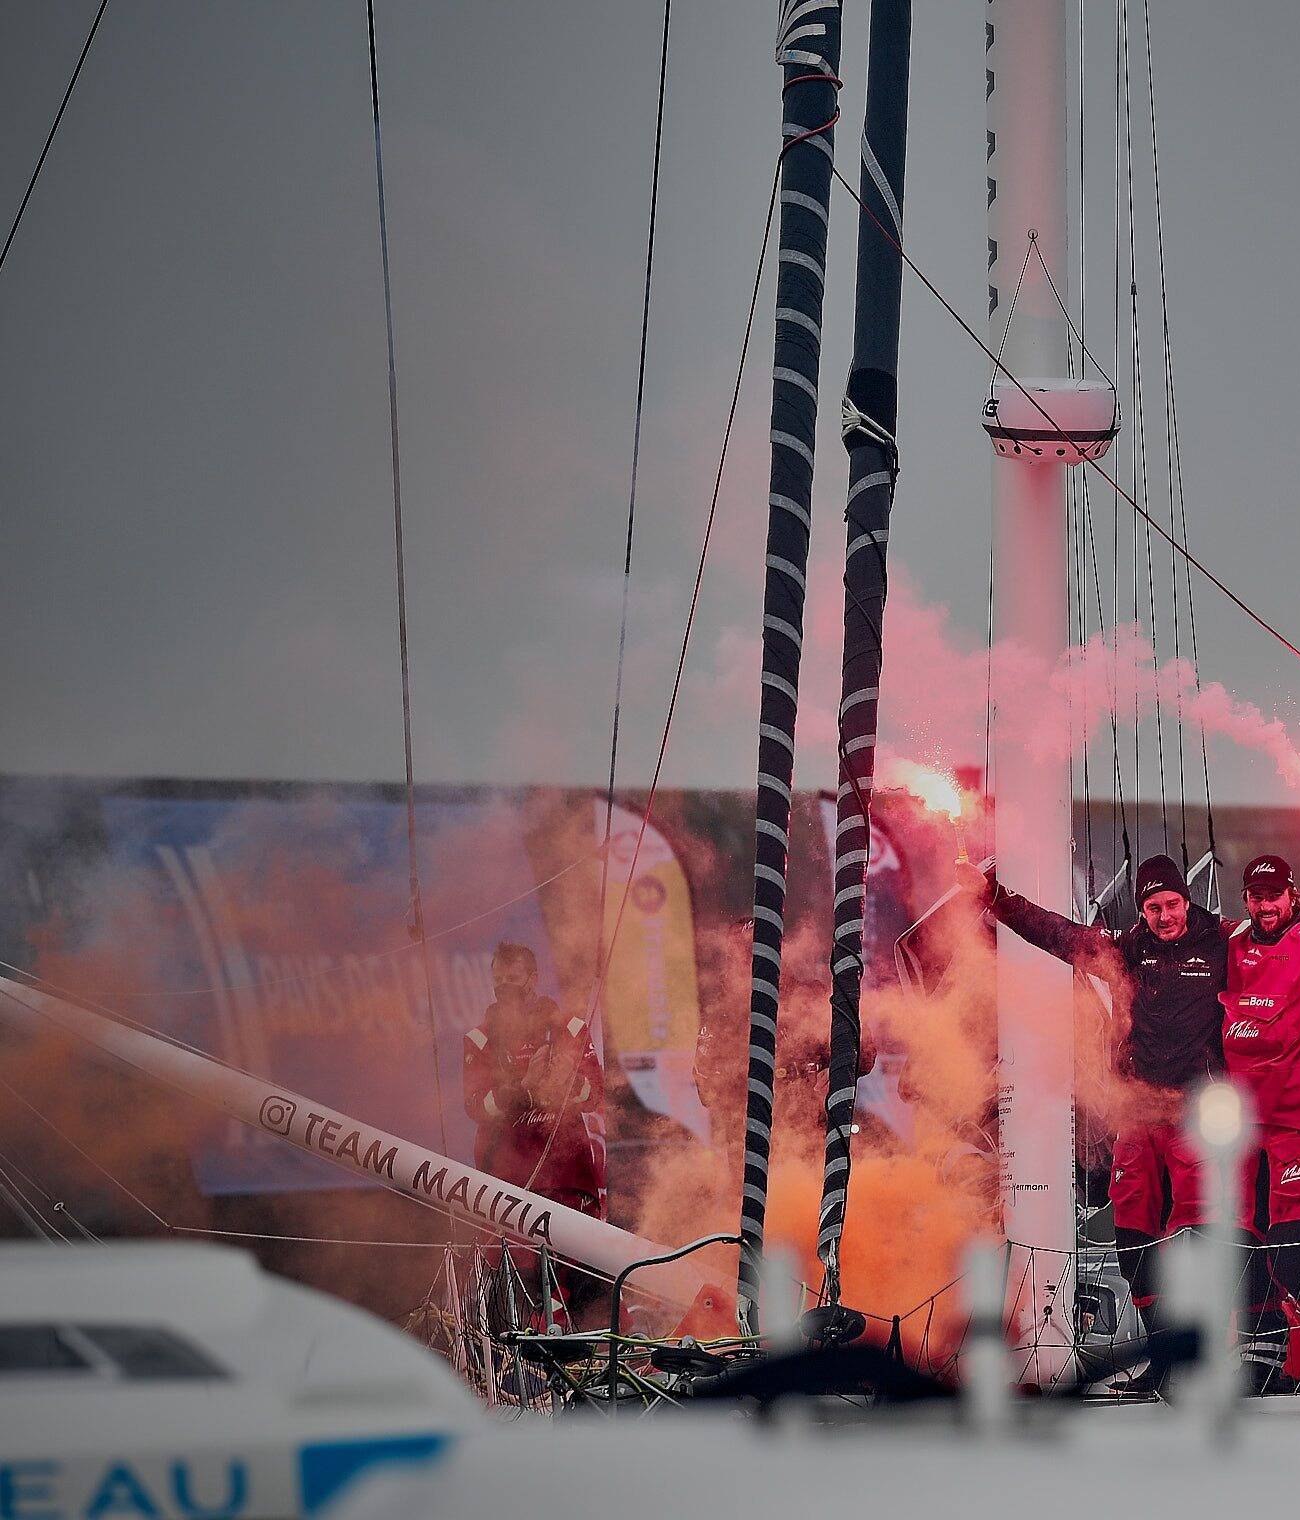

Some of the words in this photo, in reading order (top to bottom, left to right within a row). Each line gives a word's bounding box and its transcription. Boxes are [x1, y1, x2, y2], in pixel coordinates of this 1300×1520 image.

[1249, 997, 1274, 1007] Boris
[305, 1112, 398, 1179] TEAM
[412, 1160, 553, 1247] MALIZIA
